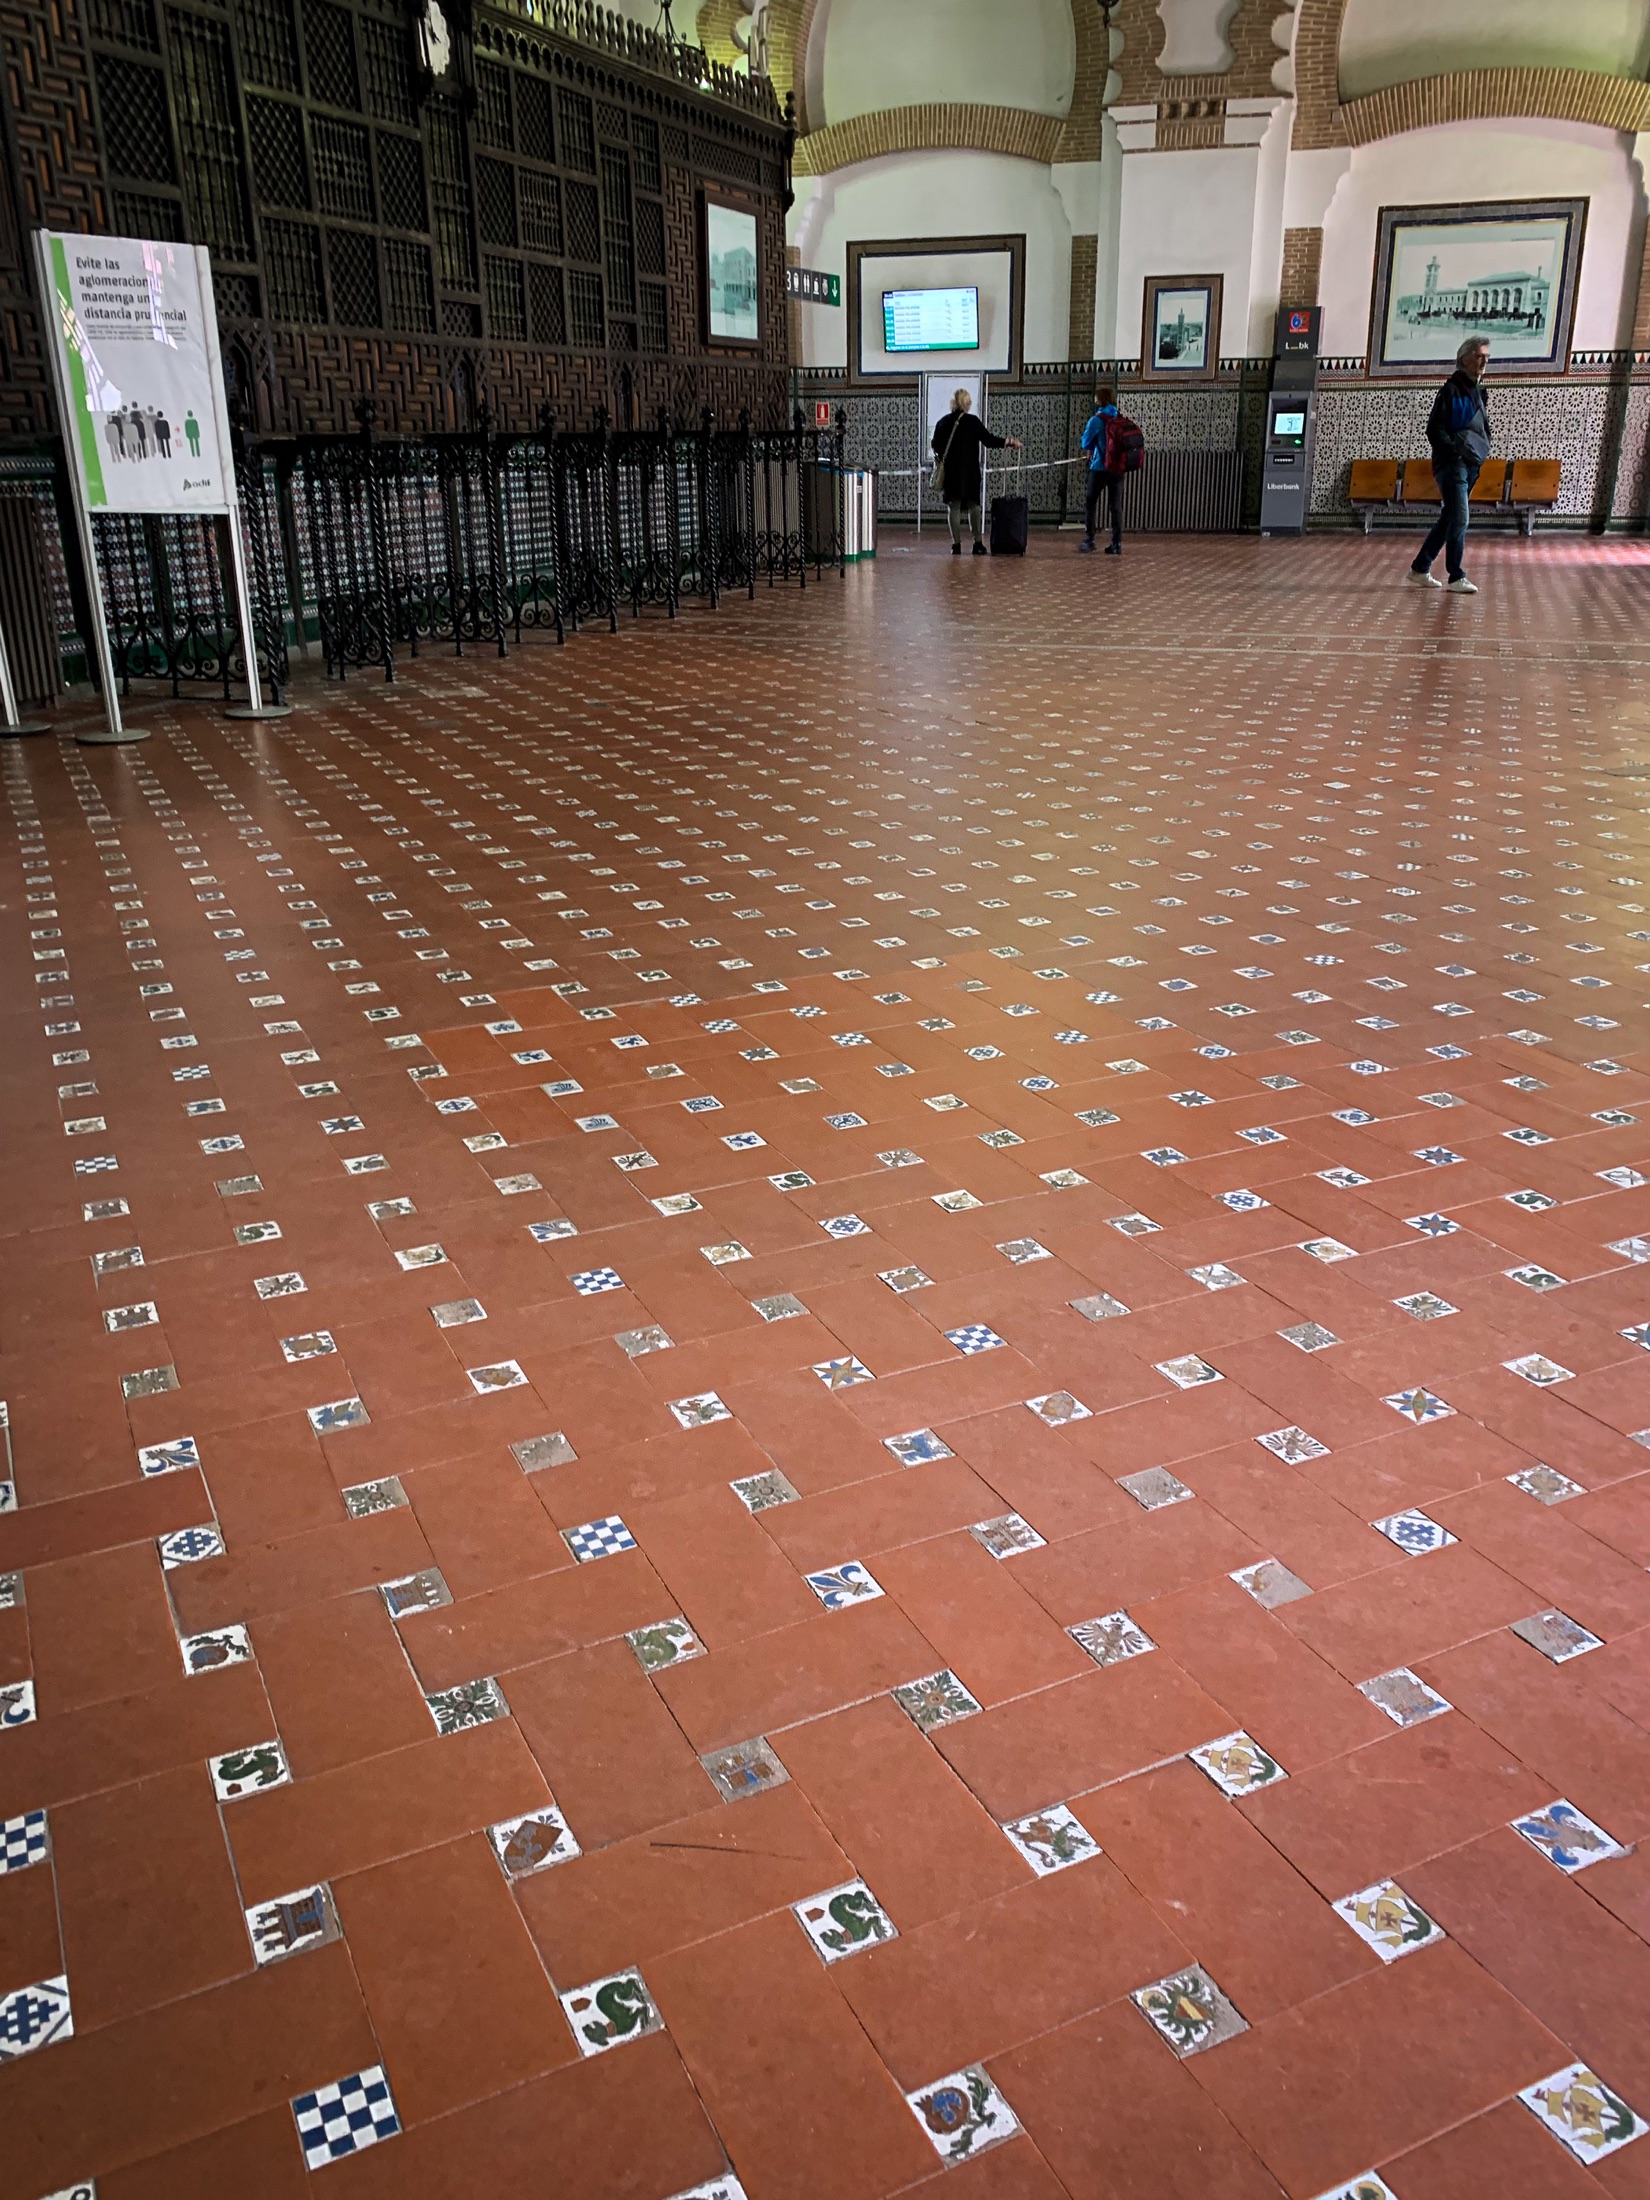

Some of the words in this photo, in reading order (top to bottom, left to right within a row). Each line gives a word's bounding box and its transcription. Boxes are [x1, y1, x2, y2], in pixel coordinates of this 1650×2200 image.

[76, 256, 102, 270] Evite
[105, 258, 120, 270] las
[79, 274, 160, 289] aglomeracion
[82, 292, 134, 306] mantenga
[84, 307, 132, 320] distancia
[134, 309, 187, 322] pruencial
